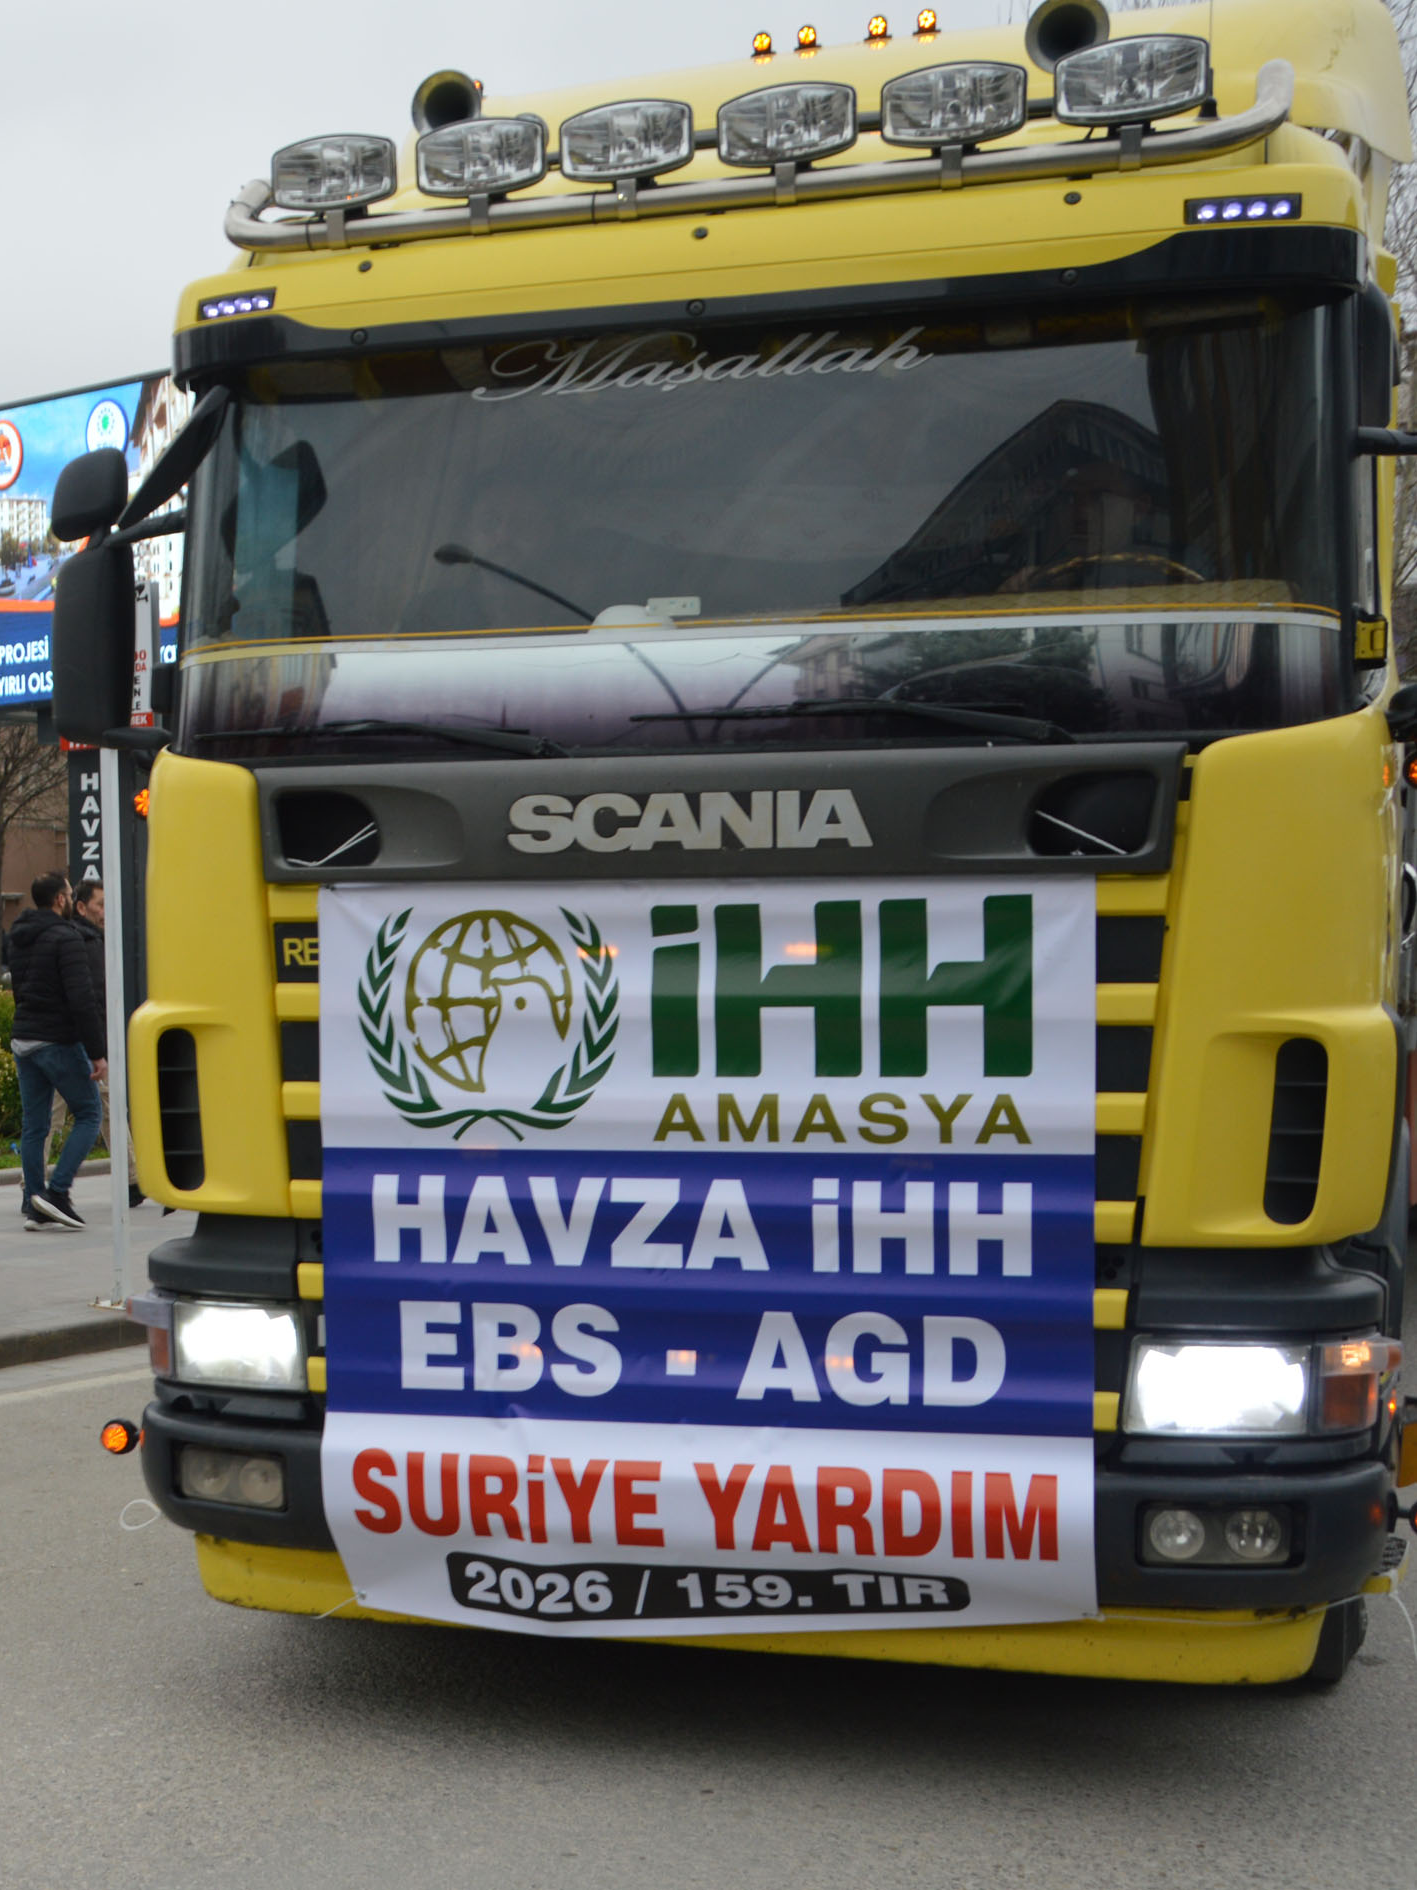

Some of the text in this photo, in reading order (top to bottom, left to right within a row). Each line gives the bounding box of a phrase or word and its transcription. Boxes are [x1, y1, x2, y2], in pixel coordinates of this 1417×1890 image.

[471, 326, 934, 401] Maşallah
[80, 772, 101, 881] HAVZA
[508, 789, 873, 855] SCANIA
[652, 1093, 1033, 1146] AMASYA
[371, 1174, 770, 1272] HAVZA
[399, 1299, 624, 1398] EBS
[735, 1310, 1008, 1408] AGD
[693, 1462, 1060, 1563] YARDIM
[464, 1560, 949, 1615] 2026 / 159. TIR
